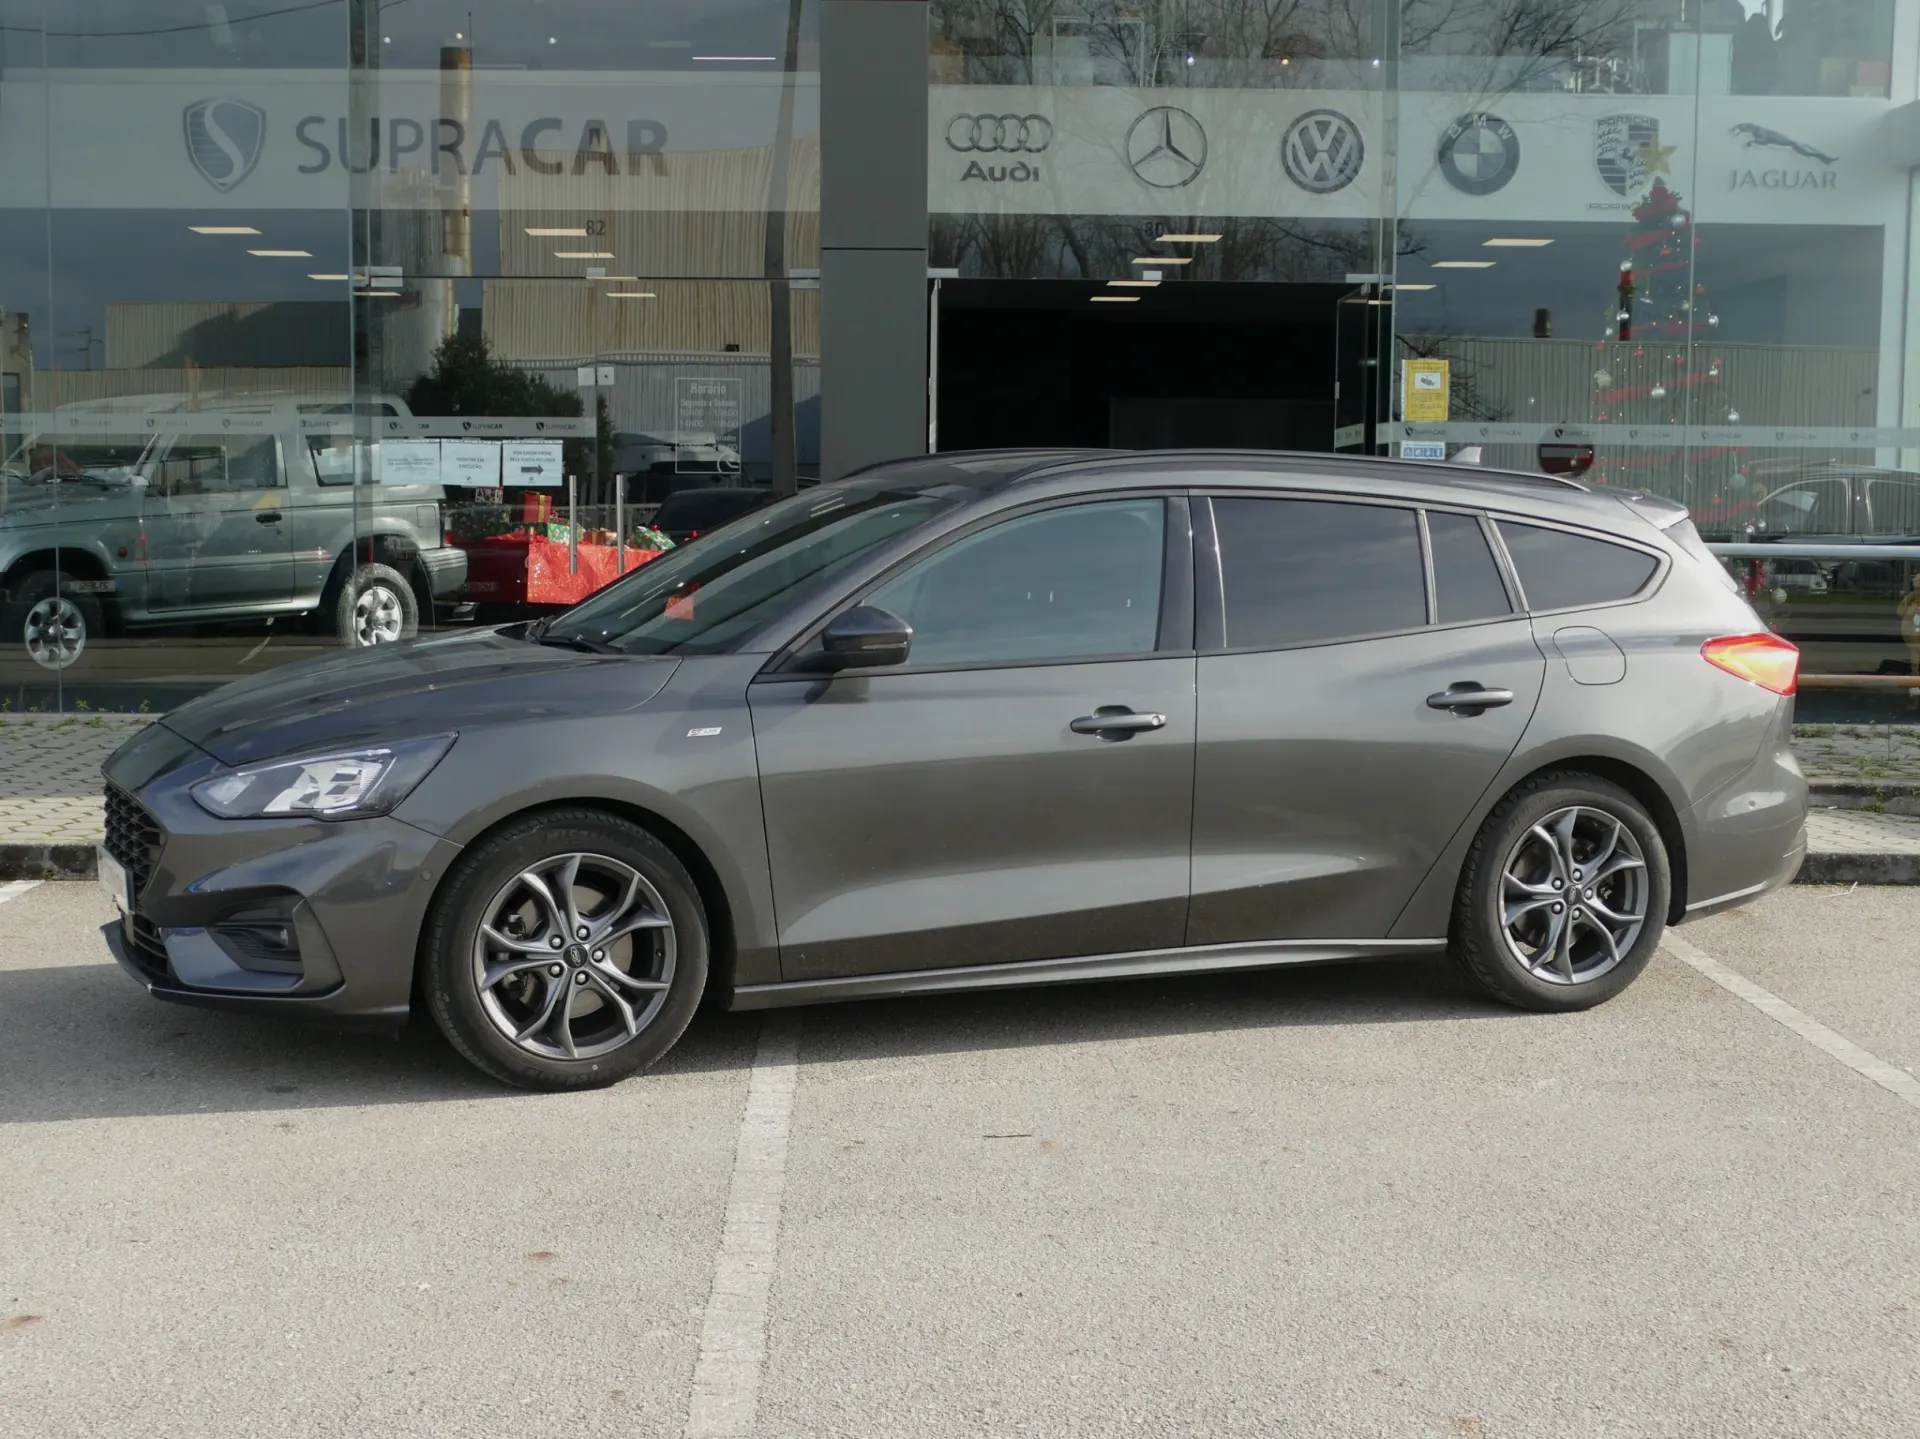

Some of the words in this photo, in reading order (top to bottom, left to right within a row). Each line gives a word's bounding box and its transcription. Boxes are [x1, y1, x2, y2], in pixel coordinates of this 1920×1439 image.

[1449, 114, 1512, 141] BMW
[295, 116, 669, 177] SUPRACAR
[960, 161, 1040, 182] Audi
[1728, 169, 1837, 191] JAGUAR
[1588, 202, 1633, 210] PORS
[585, 219, 606, 236] 82
[1144, 221, 1165, 238] 80
